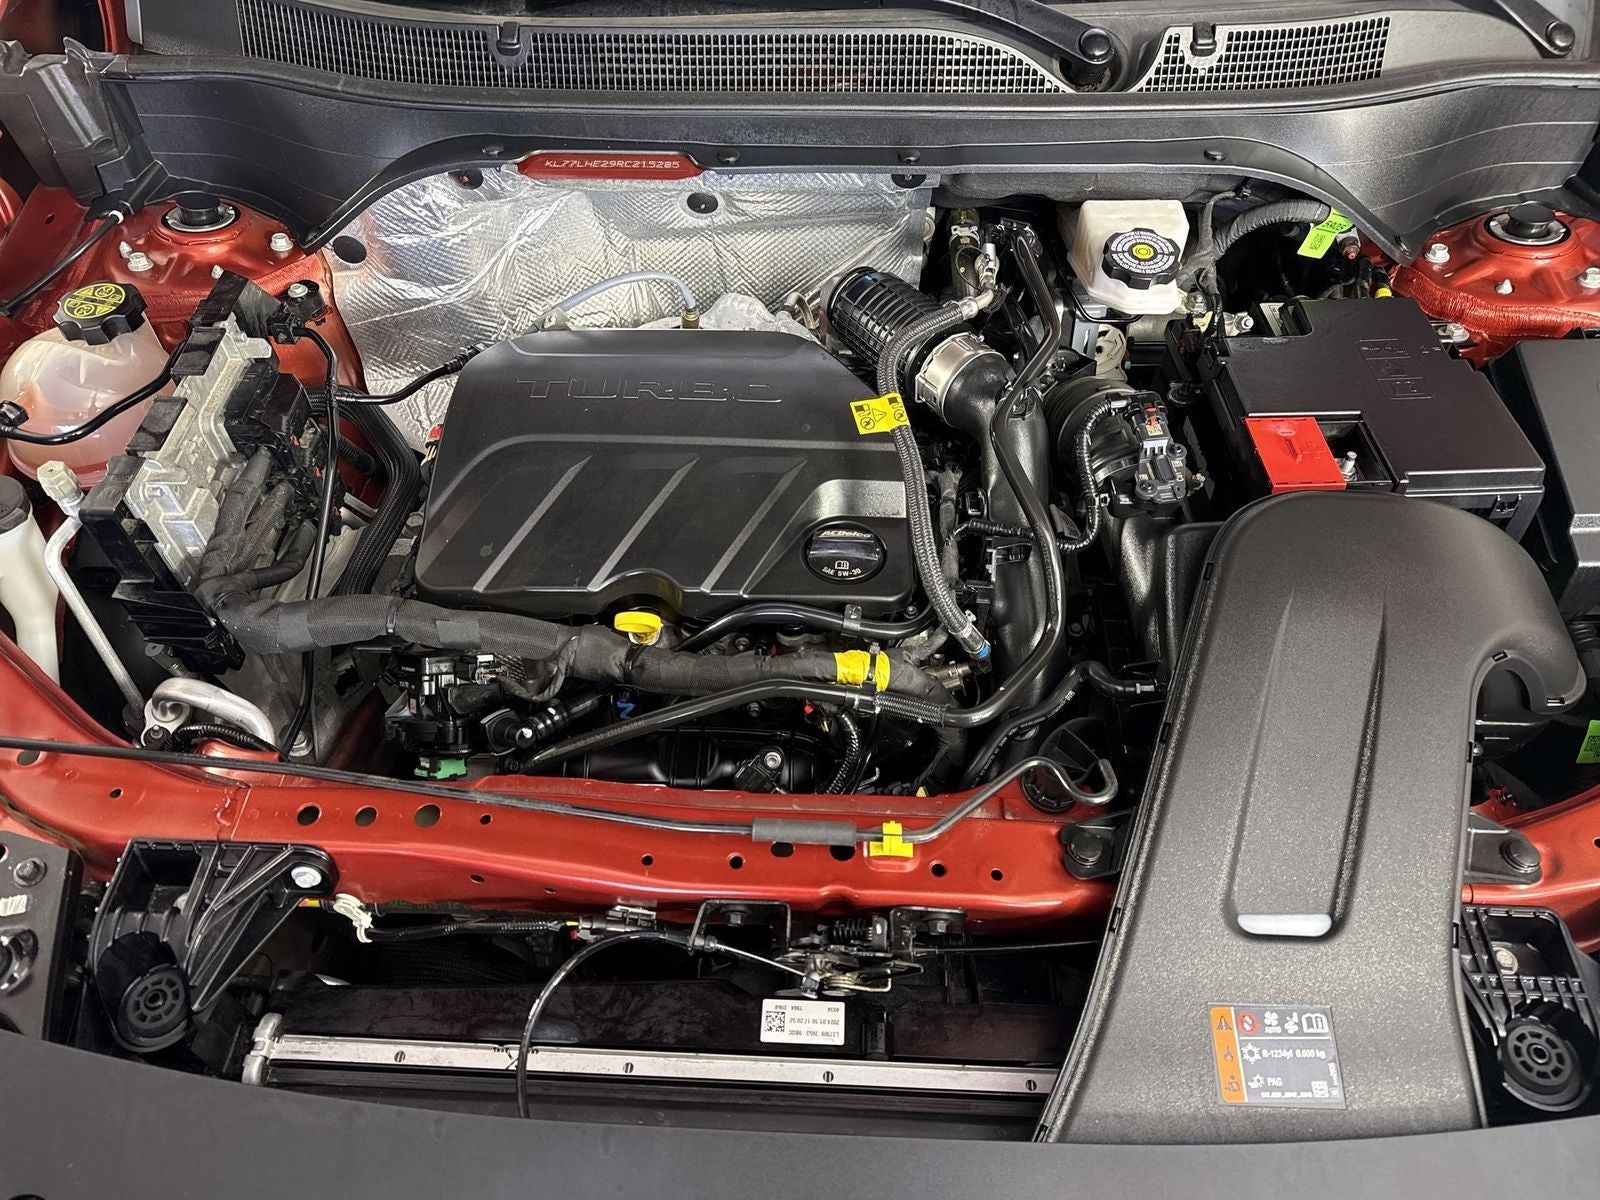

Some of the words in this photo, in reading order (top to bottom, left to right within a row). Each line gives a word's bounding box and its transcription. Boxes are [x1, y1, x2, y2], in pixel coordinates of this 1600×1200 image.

[545, 160, 680, 169] KL77LHE29RC215285
[517, 377, 782, 403] TURBO
[821, 530, 872, 538] ACDelco
[822, 566, 836, 575] SAE
[837, 567, 862, 577] 5W-30
[1265, 1026, 1281, 1034] AUTO
[1262, 1049, 1293, 1059] R-1234yf
[1316, 1049, 1326, 1059] kg
[1267, 1077, 1283, 1086] PAG
